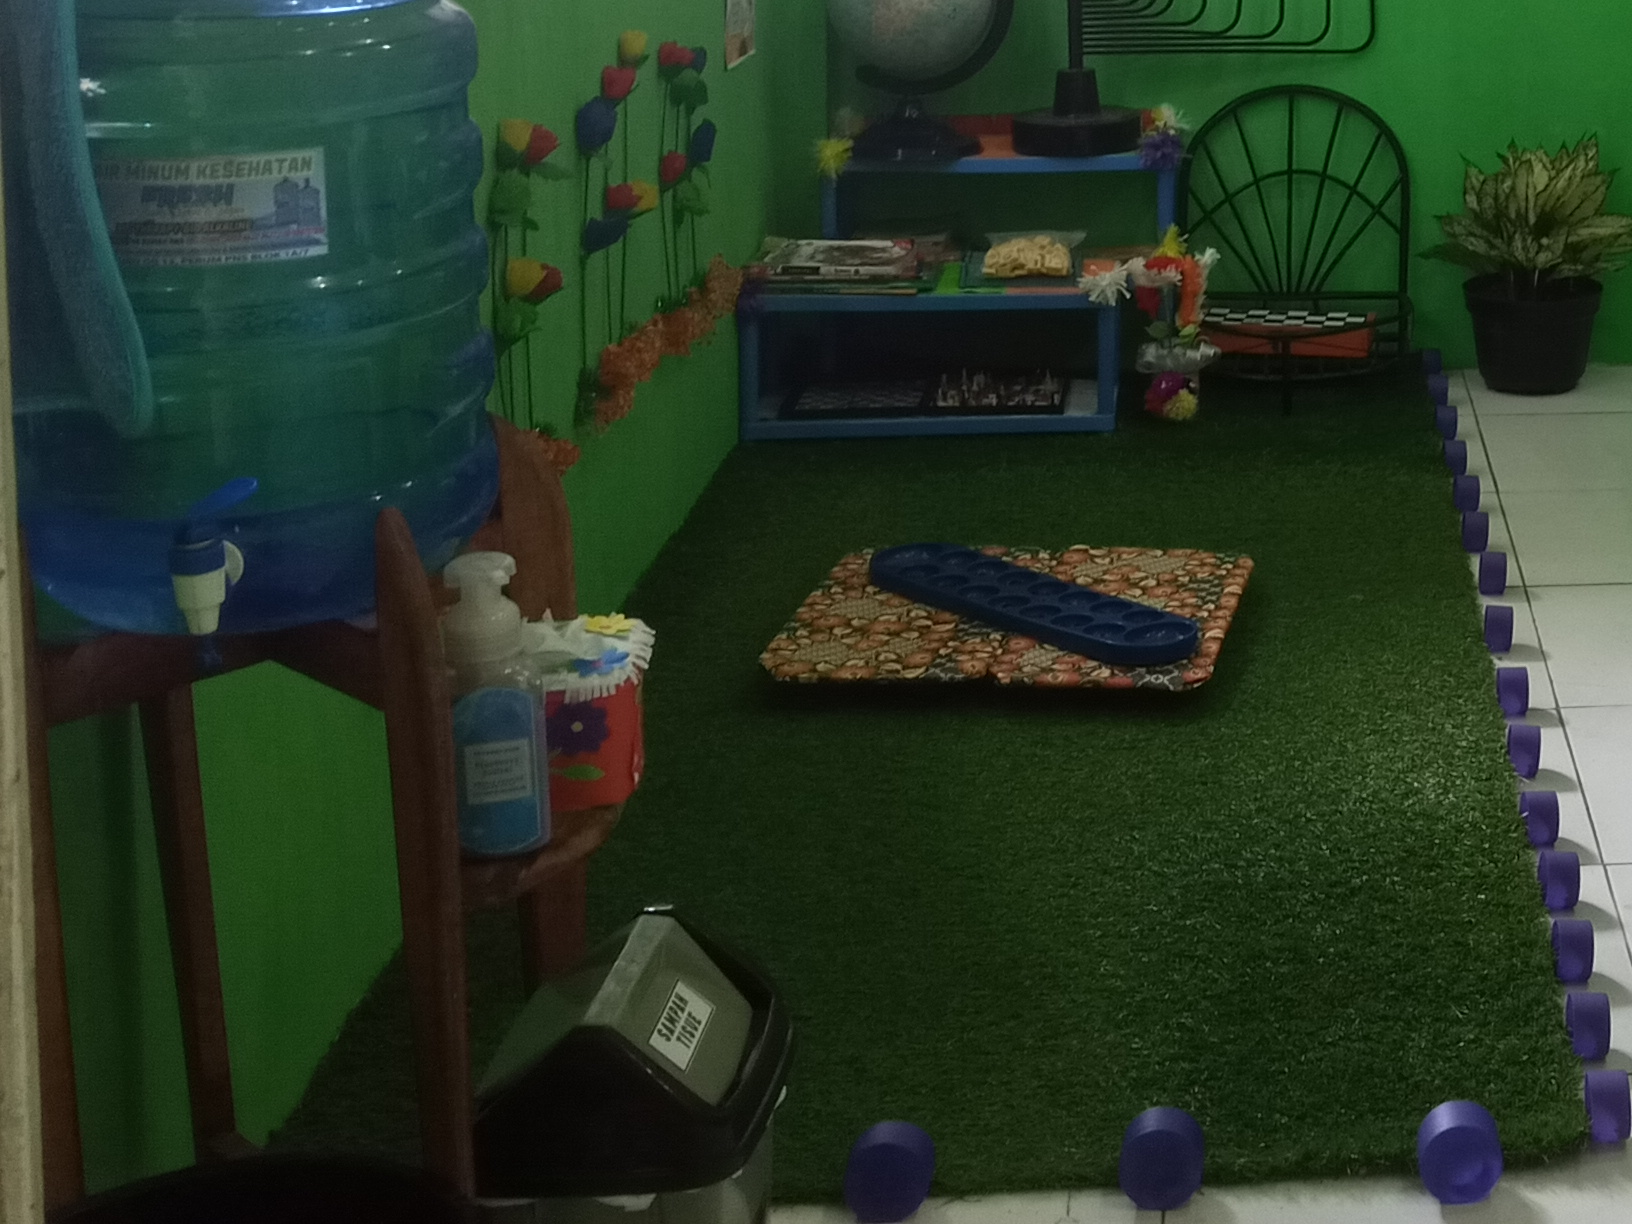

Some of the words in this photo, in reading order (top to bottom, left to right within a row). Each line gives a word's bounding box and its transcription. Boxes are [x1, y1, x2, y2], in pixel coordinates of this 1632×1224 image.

[126, 162, 190, 181] MINUM
[196, 155, 313, 181] KESEHATAN
[657, 991, 689, 1042] SAMPAH
[676, 1011, 702, 1050] TISUE
